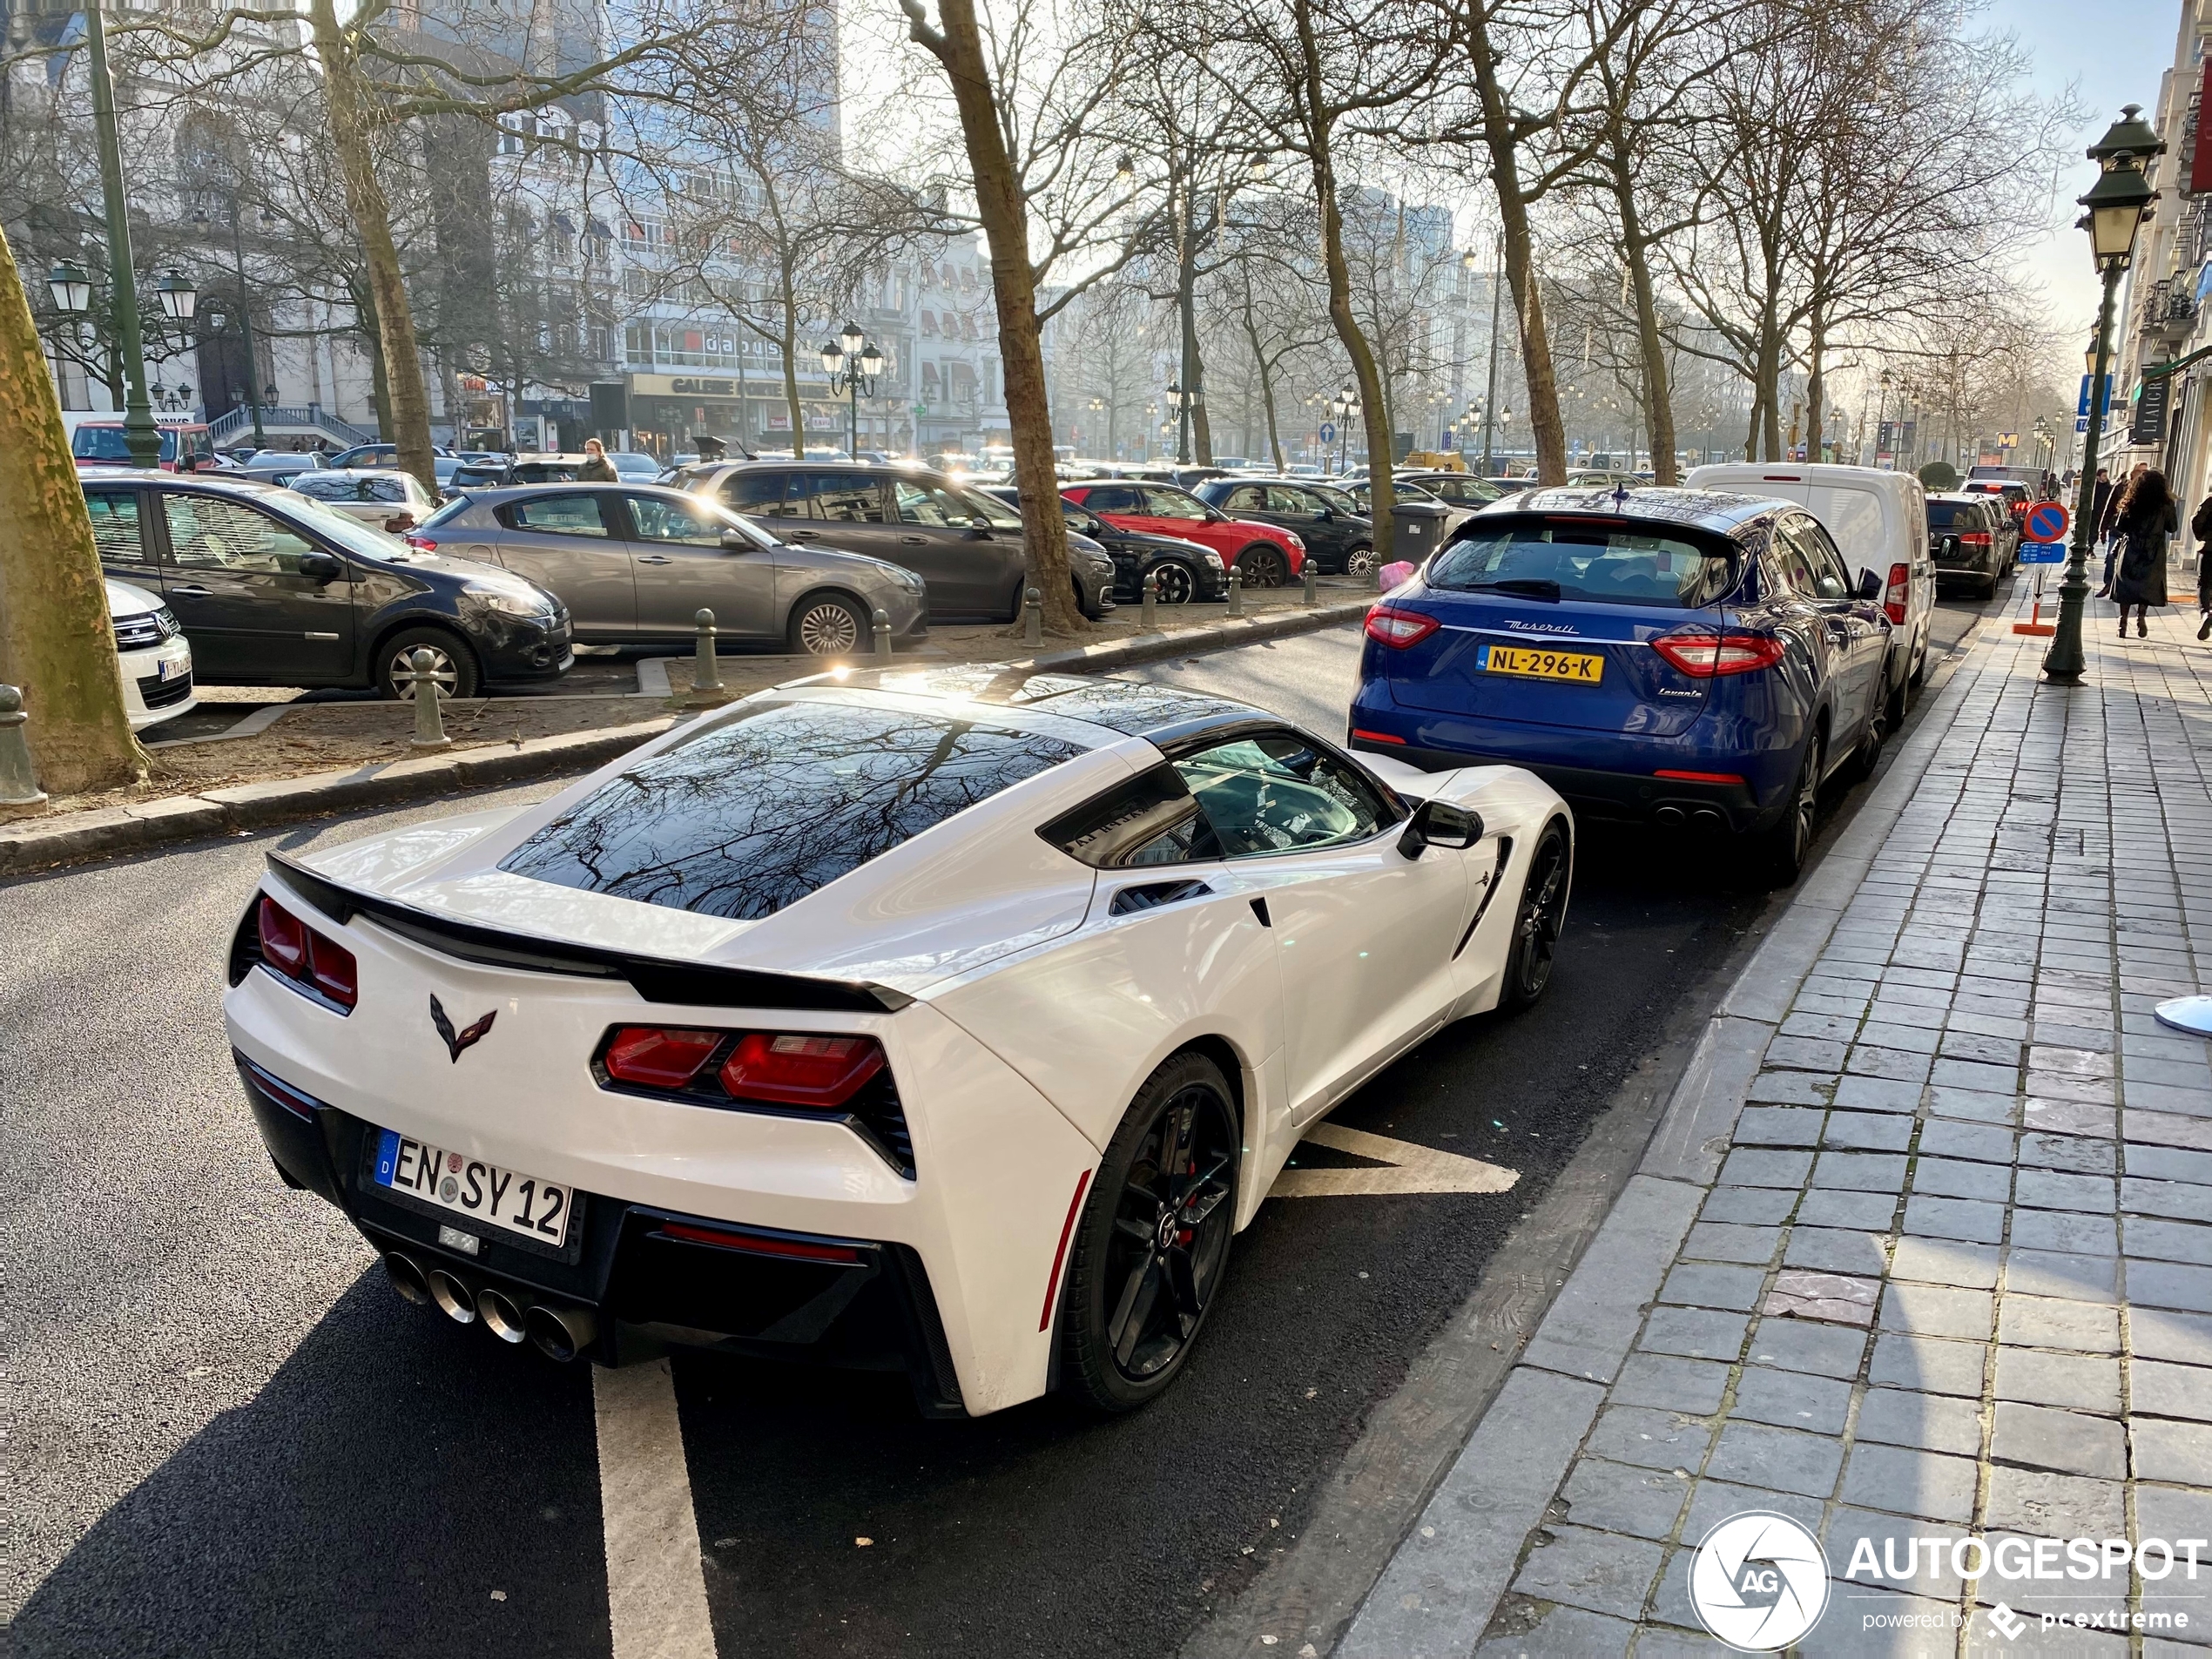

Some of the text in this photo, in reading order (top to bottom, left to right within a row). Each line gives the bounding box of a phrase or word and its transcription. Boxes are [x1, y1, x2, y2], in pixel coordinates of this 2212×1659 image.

[671, 378, 734, 395] GALERIE
[2142, 380, 2163, 433] LIAIGR
[2079, 421, 2106, 431] TAS
[1997, 434, 2020, 448] M
[1504, 620, 1580, 634] Maserati
[1492, 650, 1594, 678] NL-296-K
[1657, 688, 1703, 698] Levante
[381, 1160, 389, 1174] D
[394, 1137, 442, 1195] EN
[461, 1162, 512, 1217] SY
[513, 1180, 564, 1237] 12
